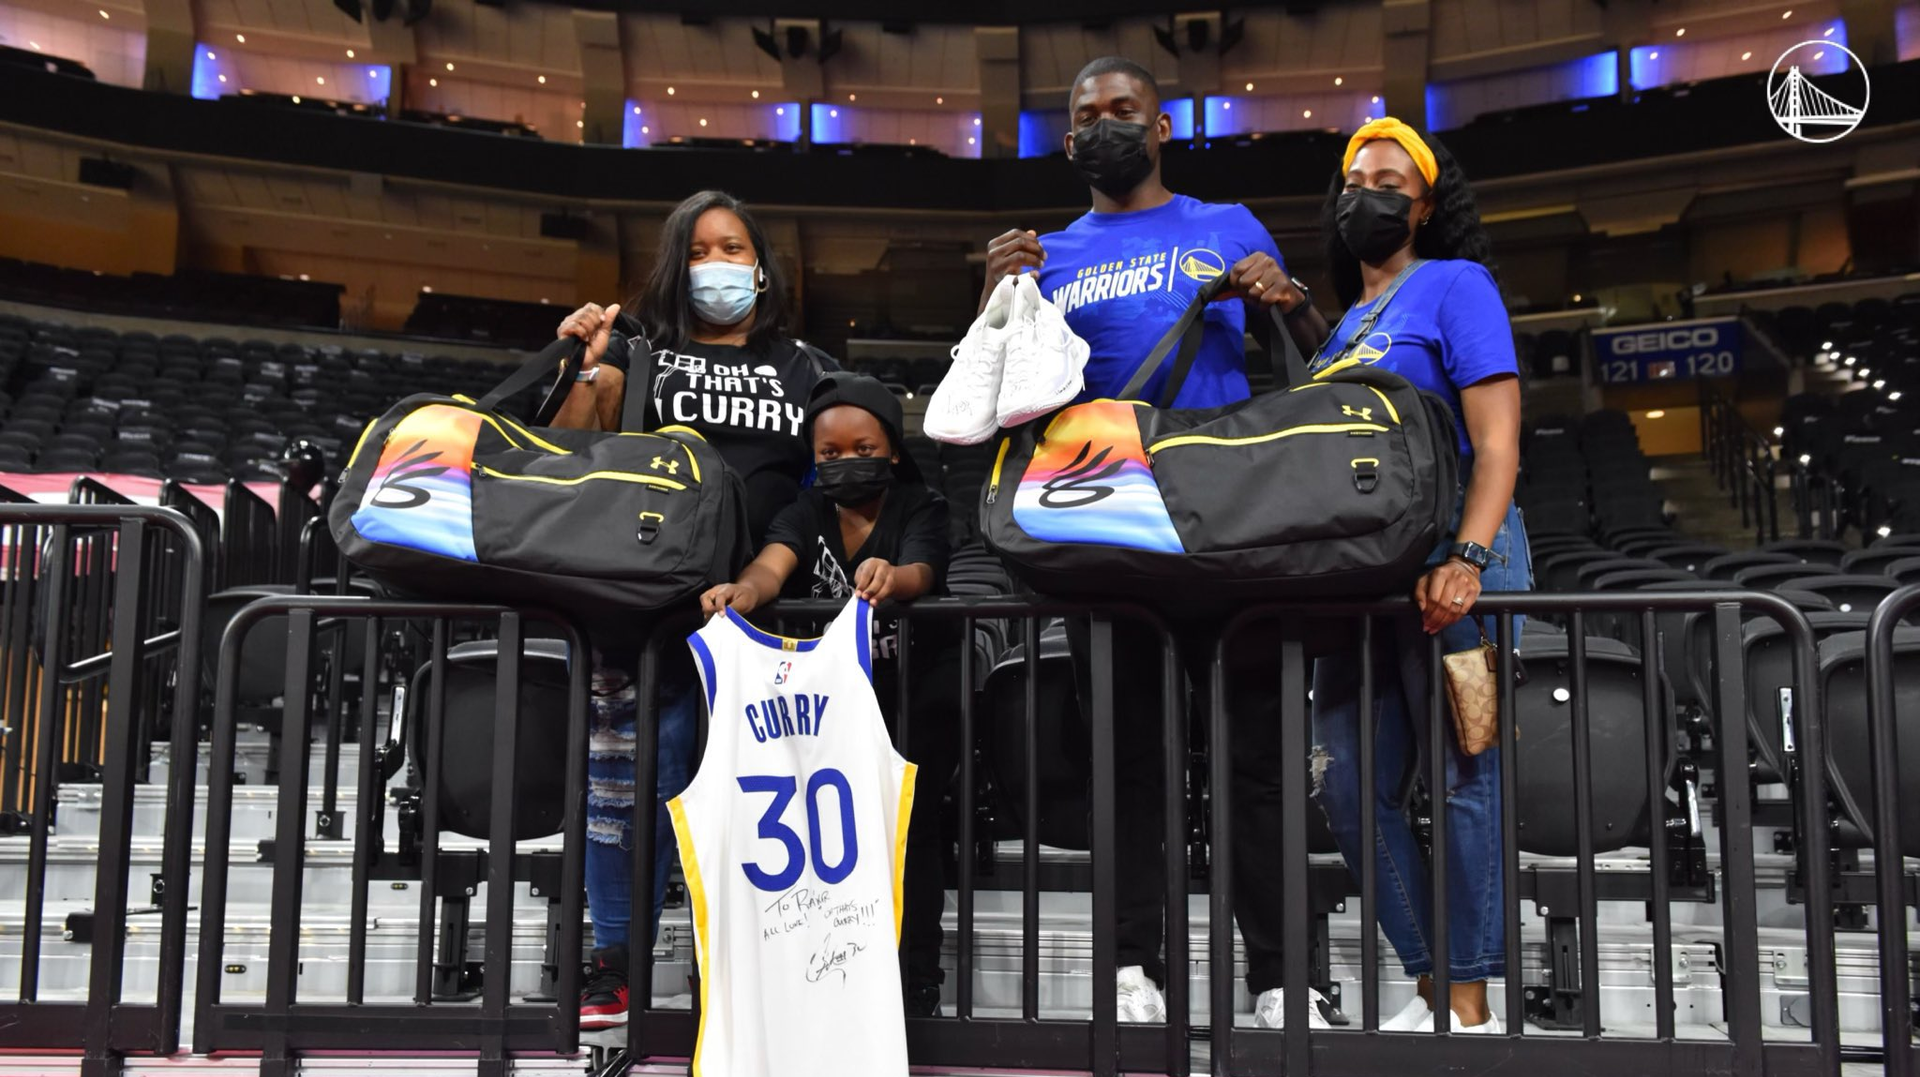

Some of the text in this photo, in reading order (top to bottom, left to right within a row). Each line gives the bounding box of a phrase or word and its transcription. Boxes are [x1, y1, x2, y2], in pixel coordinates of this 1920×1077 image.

[1077, 252, 1167, 279] GOLDEN STATE
[1052, 263, 1166, 318] WARRIORS
[1611, 327, 1719, 354] GEICO
[713, 364, 749, 377] OH
[1601, 351, 1734, 382] 121 120
[686, 372, 785, 397] THAT'S
[673, 391, 804, 436] CURRY
[745, 694, 830, 743] CURRY
[736, 768, 859, 892] 30
